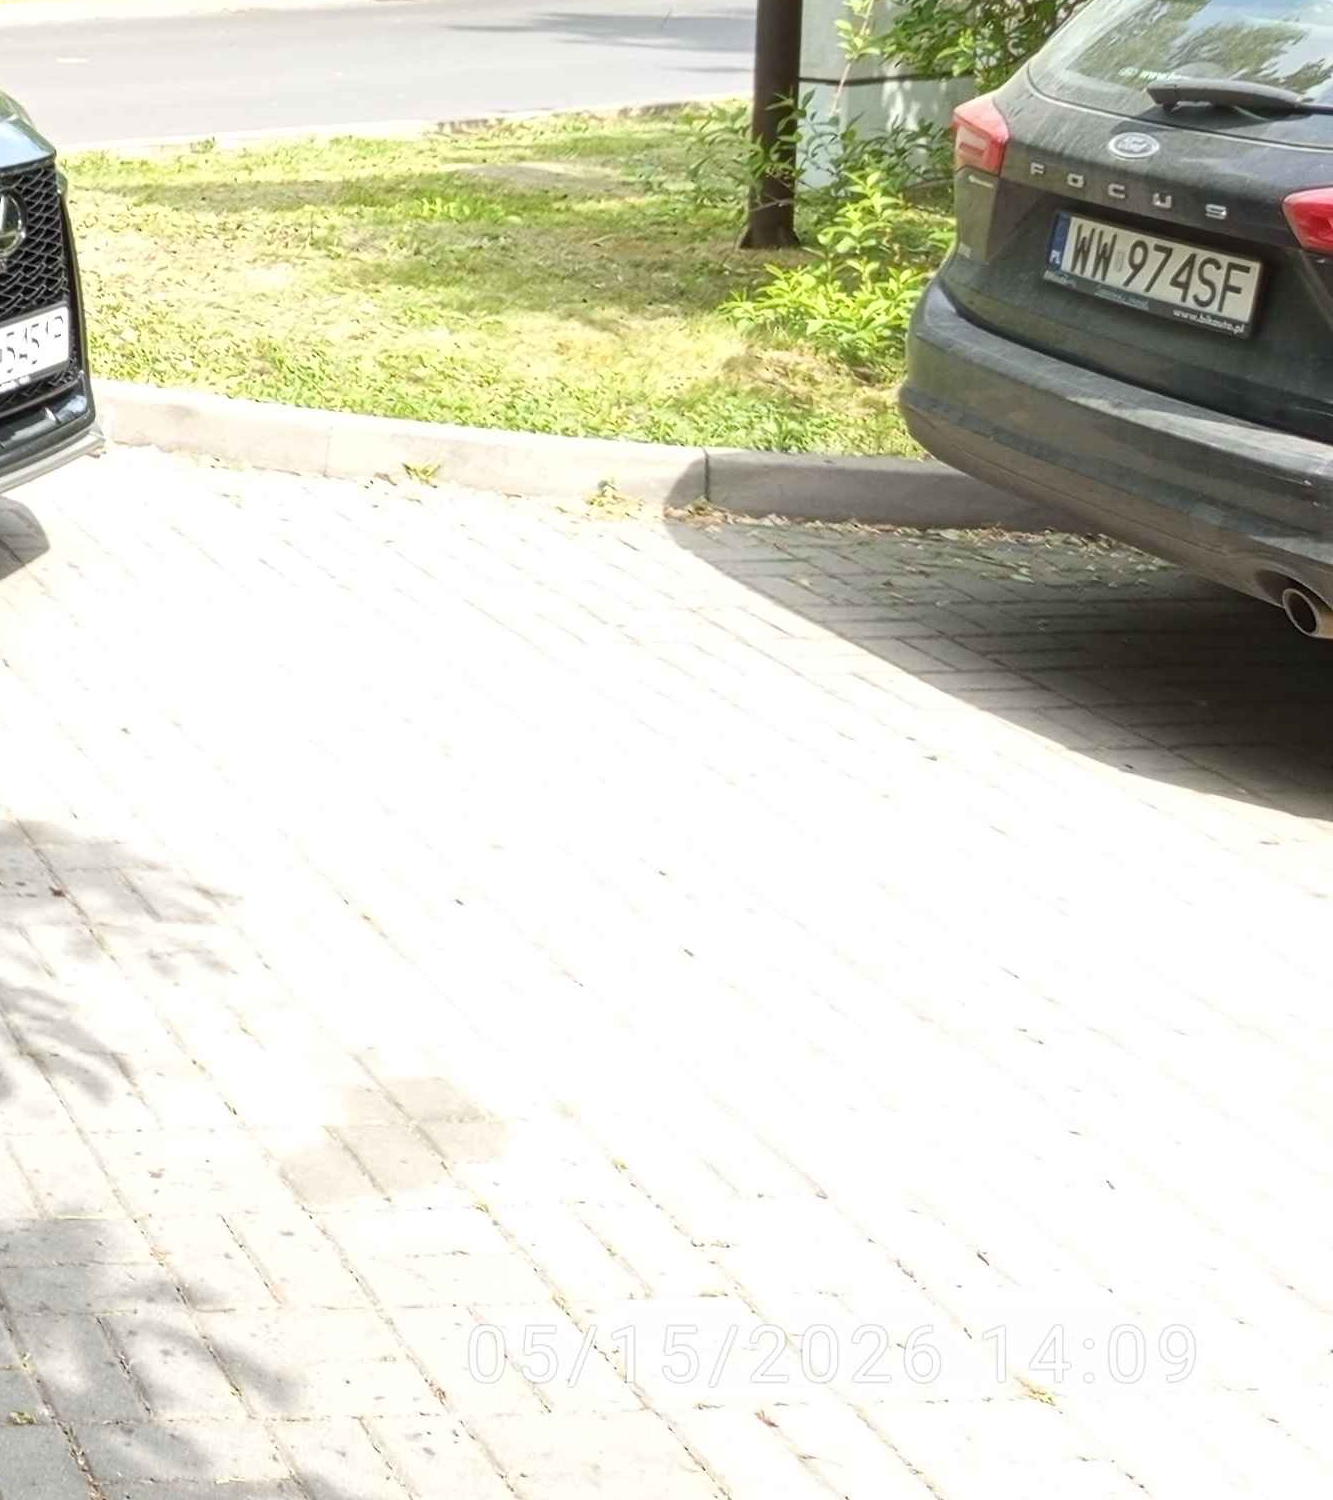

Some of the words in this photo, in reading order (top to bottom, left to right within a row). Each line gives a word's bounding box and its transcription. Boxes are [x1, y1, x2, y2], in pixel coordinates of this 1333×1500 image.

[1030, 161, 1228, 220] FOCUS
[1070, 223, 1118, 282] WW
[1122, 239, 1251, 313] 974SF
